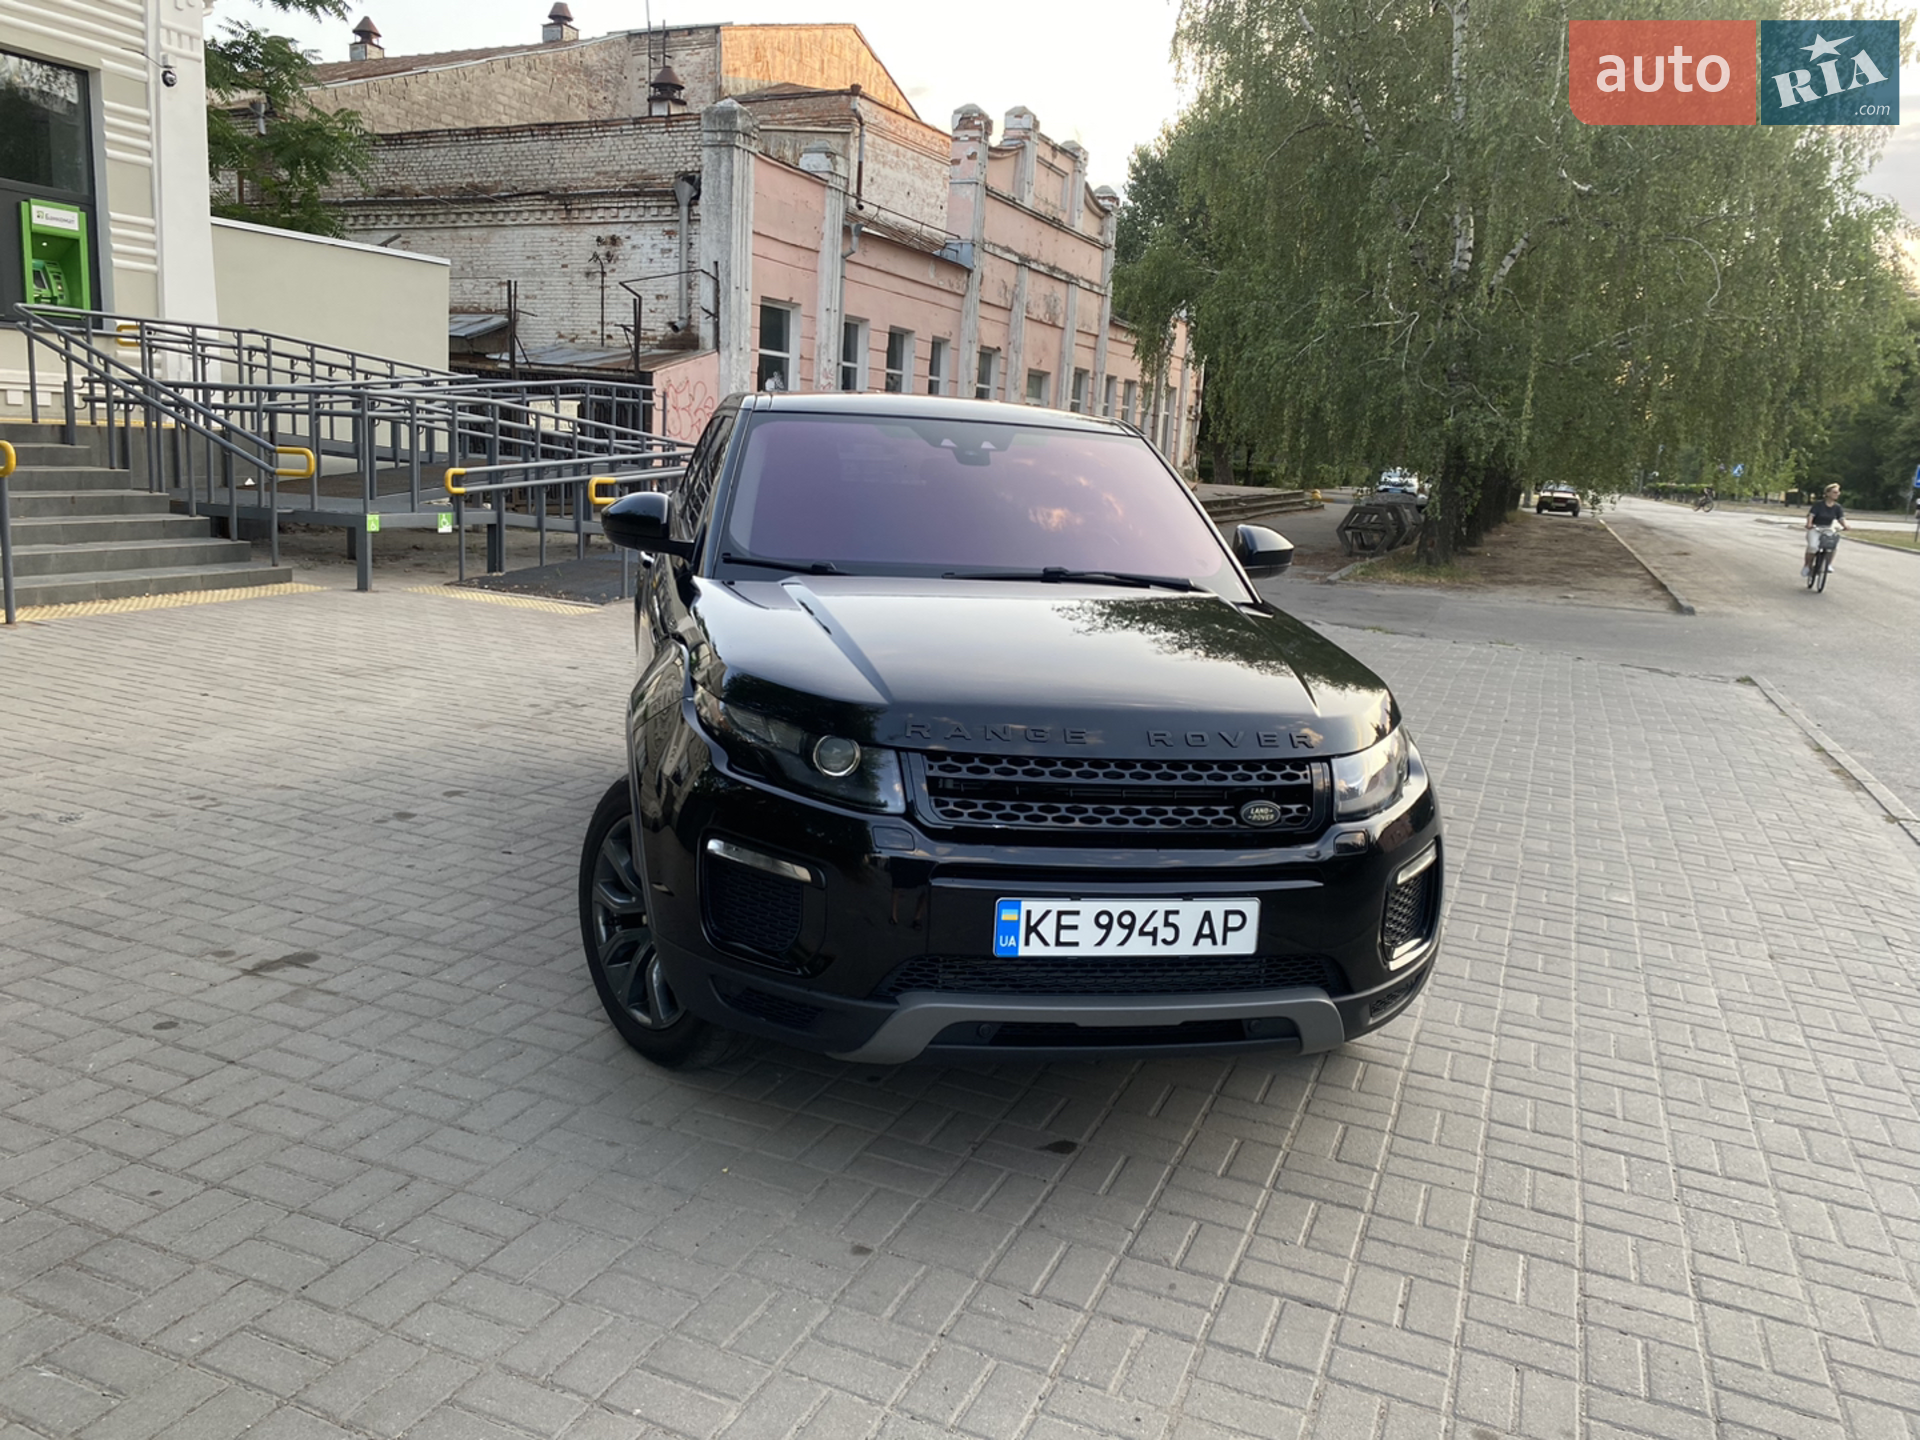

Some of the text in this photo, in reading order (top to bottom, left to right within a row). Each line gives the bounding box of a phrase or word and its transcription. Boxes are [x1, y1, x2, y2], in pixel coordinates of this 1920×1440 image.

[904, 721, 1316, 749] RANGE ROVER
[999, 935, 1017, 947] UA
[1023, 908, 1248, 947] KE 9945 AP
